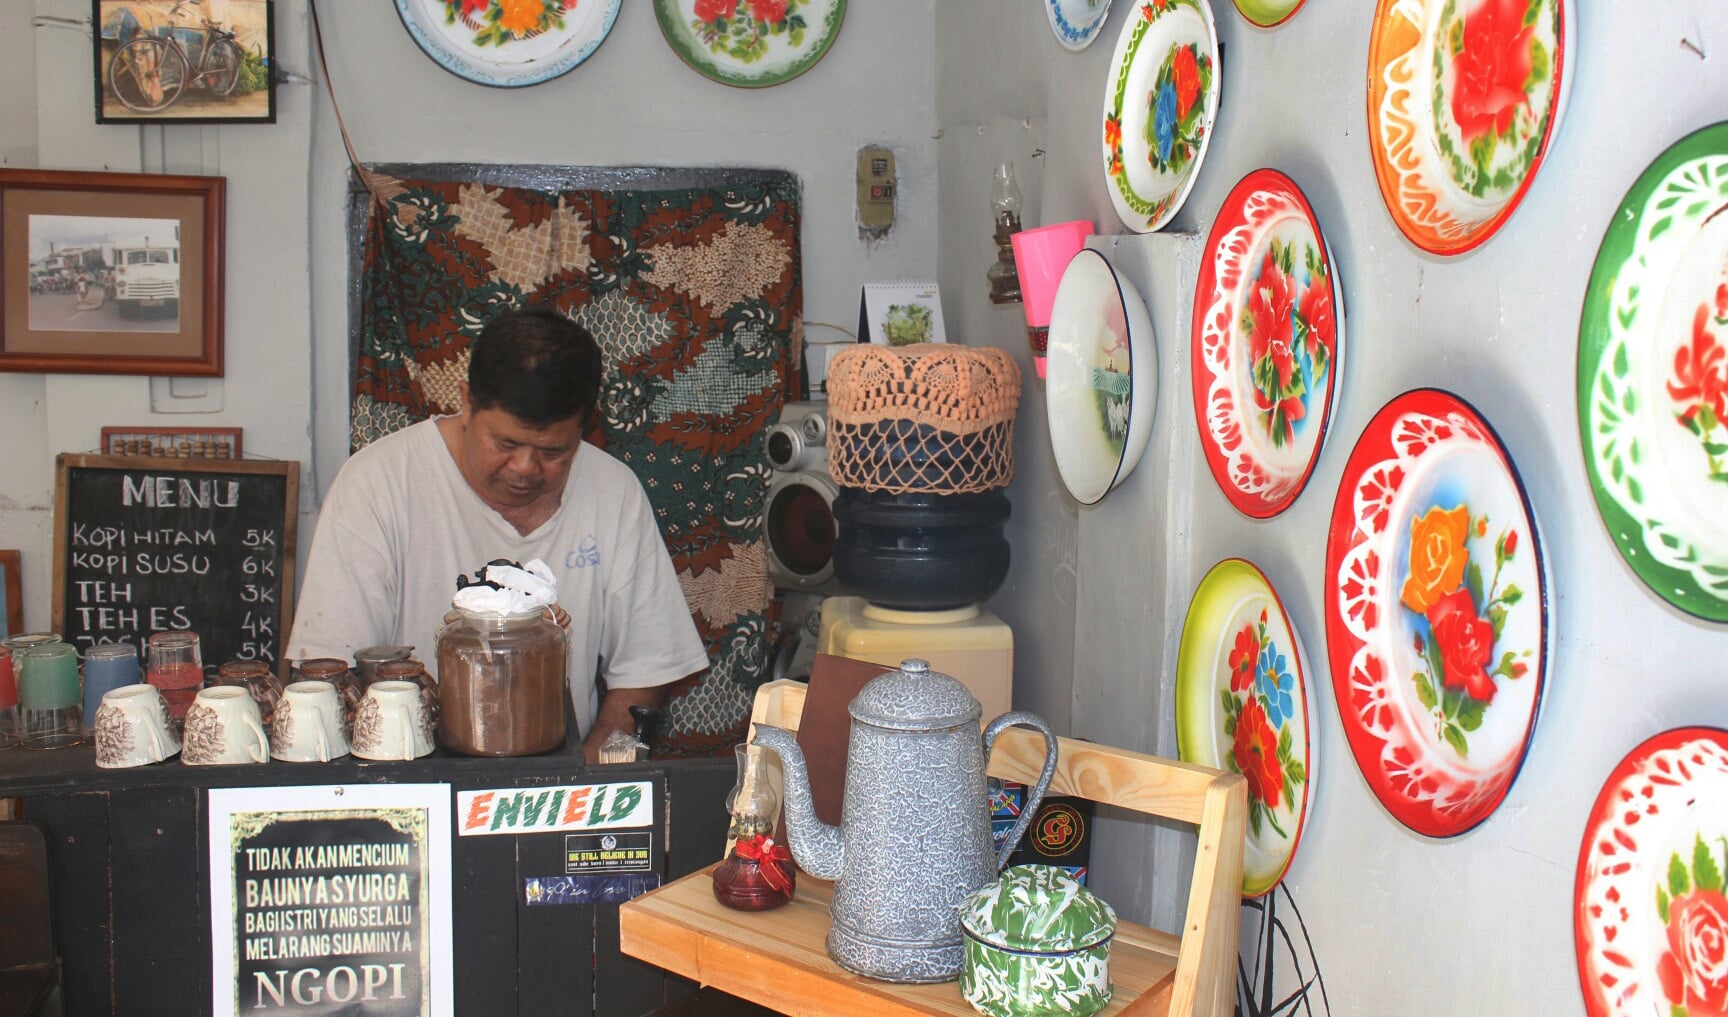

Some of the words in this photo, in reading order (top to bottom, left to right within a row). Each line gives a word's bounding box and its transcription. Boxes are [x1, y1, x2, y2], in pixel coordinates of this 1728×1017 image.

[122, 474, 240, 508] MENU
[133, 529, 216, 546] HITAM
[242, 529, 275, 546] 5K
[136, 553, 210, 574] SUSU
[242, 556, 275, 576] 6K
[75, 581, 132, 603] TEH
[240, 584, 275, 603] 3K
[76, 607, 139, 630] TEH
[150, 606, 191, 630] ES
[241, 611, 273, 638] 4K
[236, 640, 274, 661] 5K
[465, 785, 643, 831] ENVIELD
[246, 847, 292, 871] TIDAK
[294, 845, 338, 869] AKAN
[339, 843, 409, 867] MENCIUM
[246, 876, 329, 908] BAUNYA
[331, 873, 410, 904] SYURGA
[245, 910, 279, 934] BAGI
[279, 908, 317, 932] ISTRI
[318, 907, 357, 930] YANG
[360, 905, 412, 927] SELALU
[246, 935, 331, 961] MELARANG
[333, 931, 412, 956] SUAMINYA
[253, 963, 406, 1009] NGOPI
